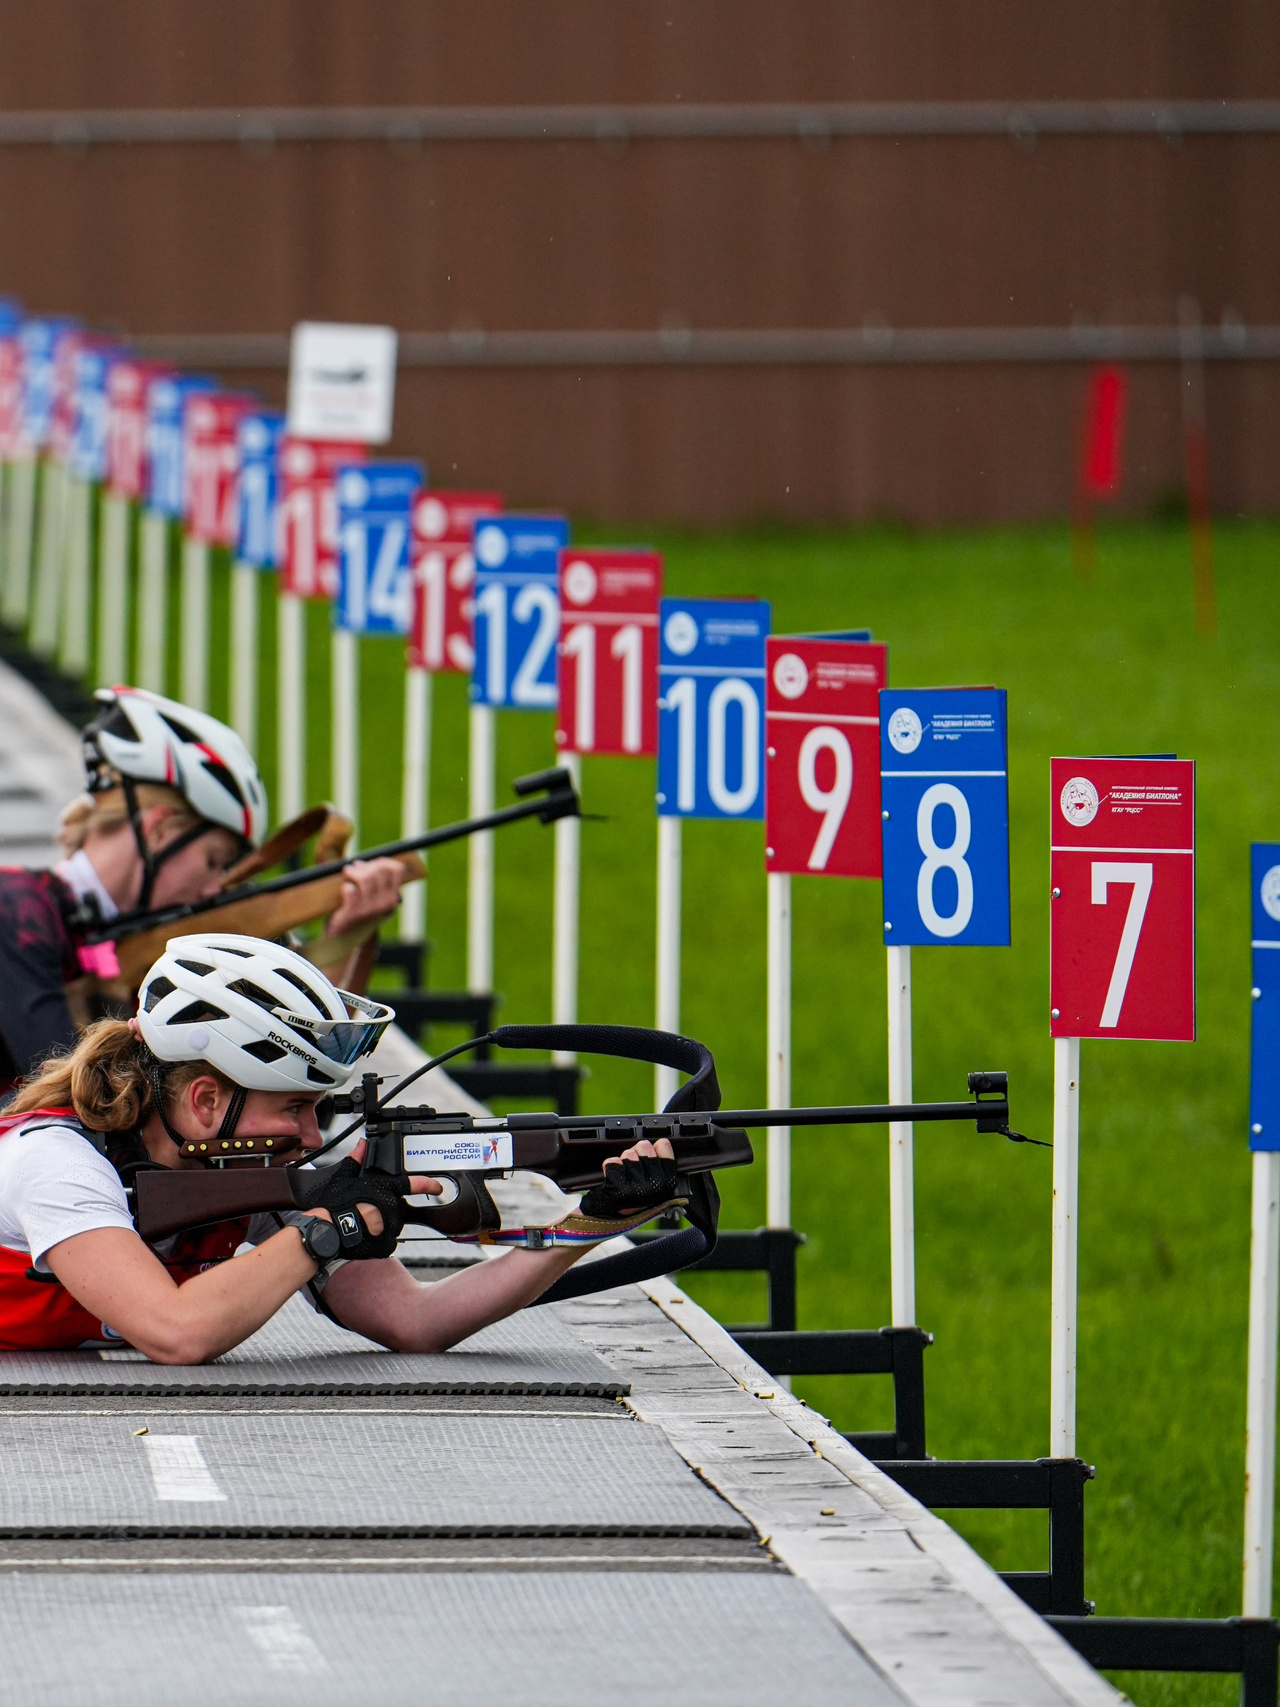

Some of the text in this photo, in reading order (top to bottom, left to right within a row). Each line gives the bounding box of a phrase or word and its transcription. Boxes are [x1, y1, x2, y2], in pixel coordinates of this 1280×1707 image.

[342, 518, 415, 631] 14
[477, 582, 560, 703] 12
[564, 623, 643, 753] 11
[666, 677, 760, 814] 10
[797, 725, 853, 870] 9
[916, 783, 974, 938] 8
[1091, 862, 1153, 1028] 7
[267, 1031, 318, 1066] ROCKBROS
[406, 1148, 480, 1156] БИАТЛОНИСТОВ
